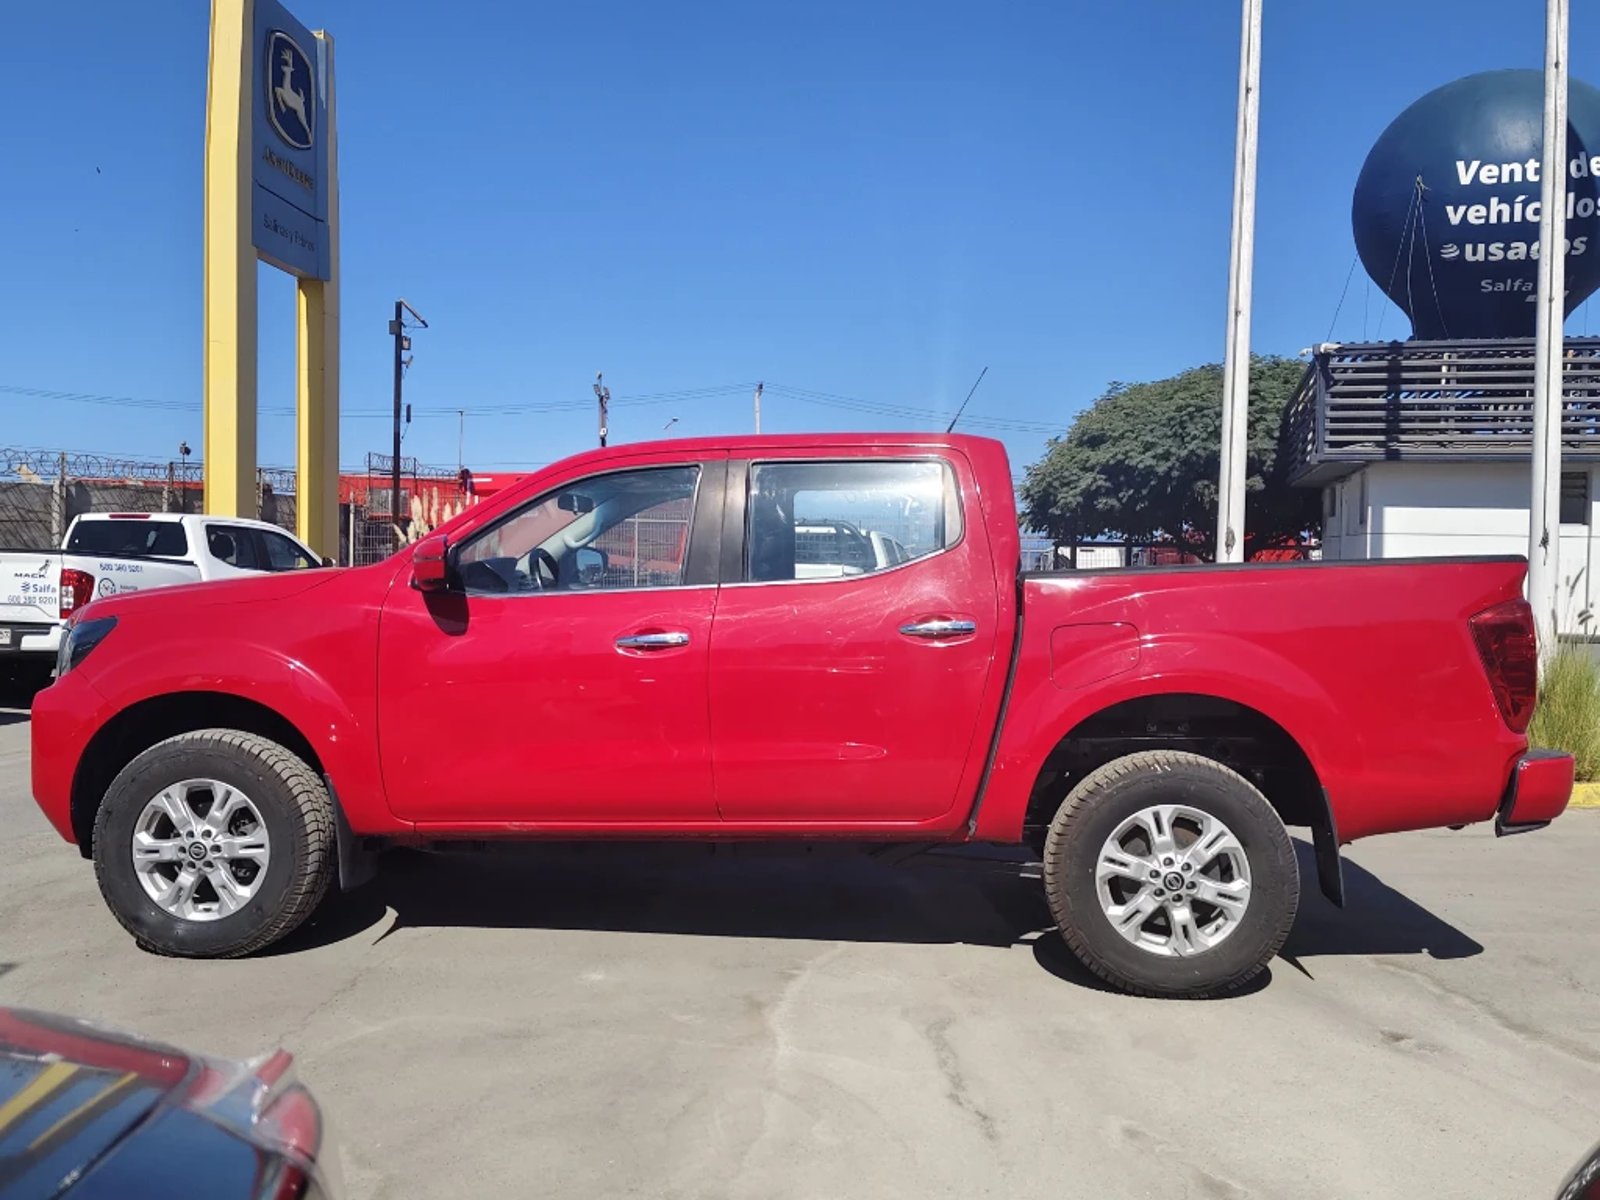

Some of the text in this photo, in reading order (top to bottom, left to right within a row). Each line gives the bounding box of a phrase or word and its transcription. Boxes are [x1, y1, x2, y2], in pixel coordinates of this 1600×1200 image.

[1455, 158, 1542, 185] Vent
[1445, 192, 1600, 226] vehíclo
[1480, 278, 1533, 292] Salfa
[32, 583, 57, 593] Salfa
